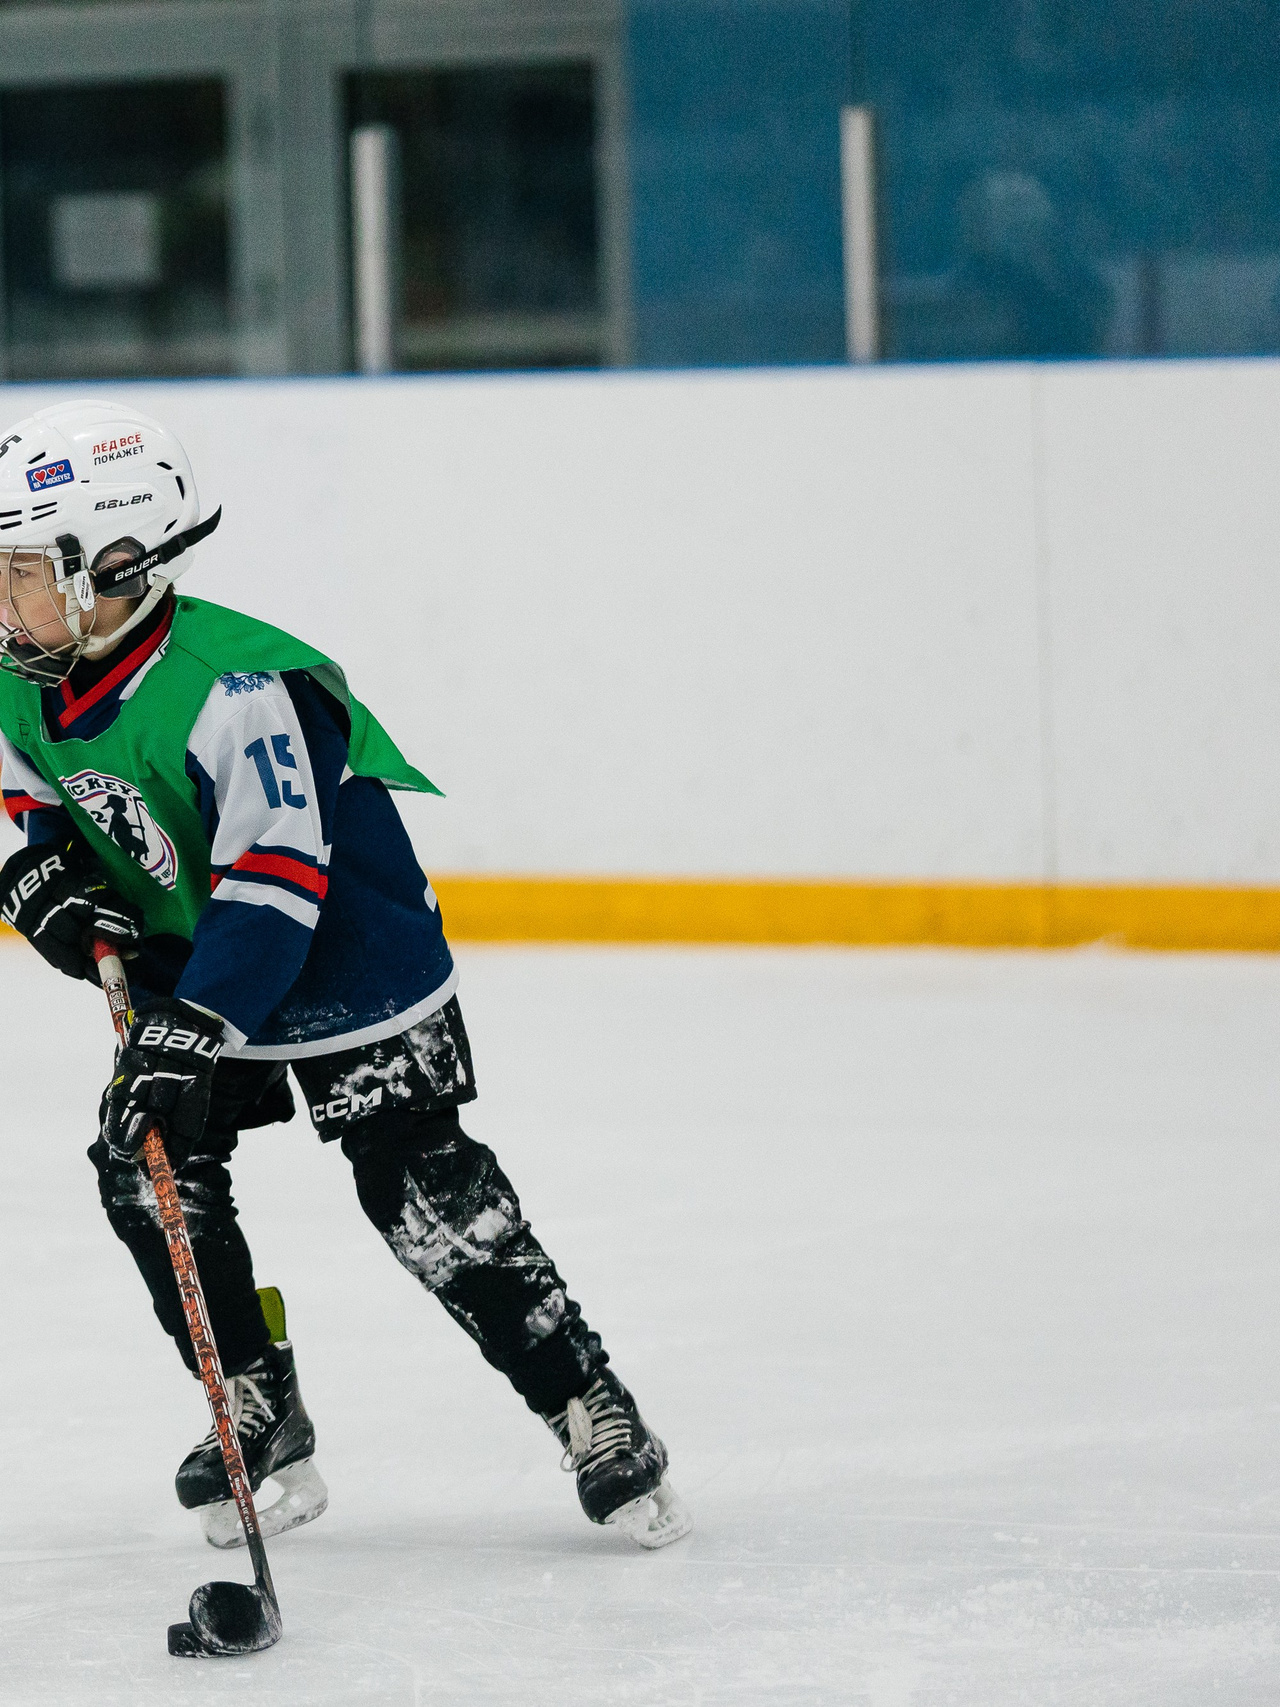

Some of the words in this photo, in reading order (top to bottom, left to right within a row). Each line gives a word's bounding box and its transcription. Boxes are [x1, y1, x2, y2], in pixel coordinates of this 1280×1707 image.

[92, 440, 118, 455] ЛЁД
[119, 431, 142, 447] ВСЁ
[93, 445, 145, 466] ПОКАЖЕТ
[94, 493, 153, 511] BAUER
[114, 553, 159, 582] BAUER
[243, 733, 308, 810] 15
[137, 1025, 225, 1064] BAU
[311, 1087, 383, 1123] CCM
